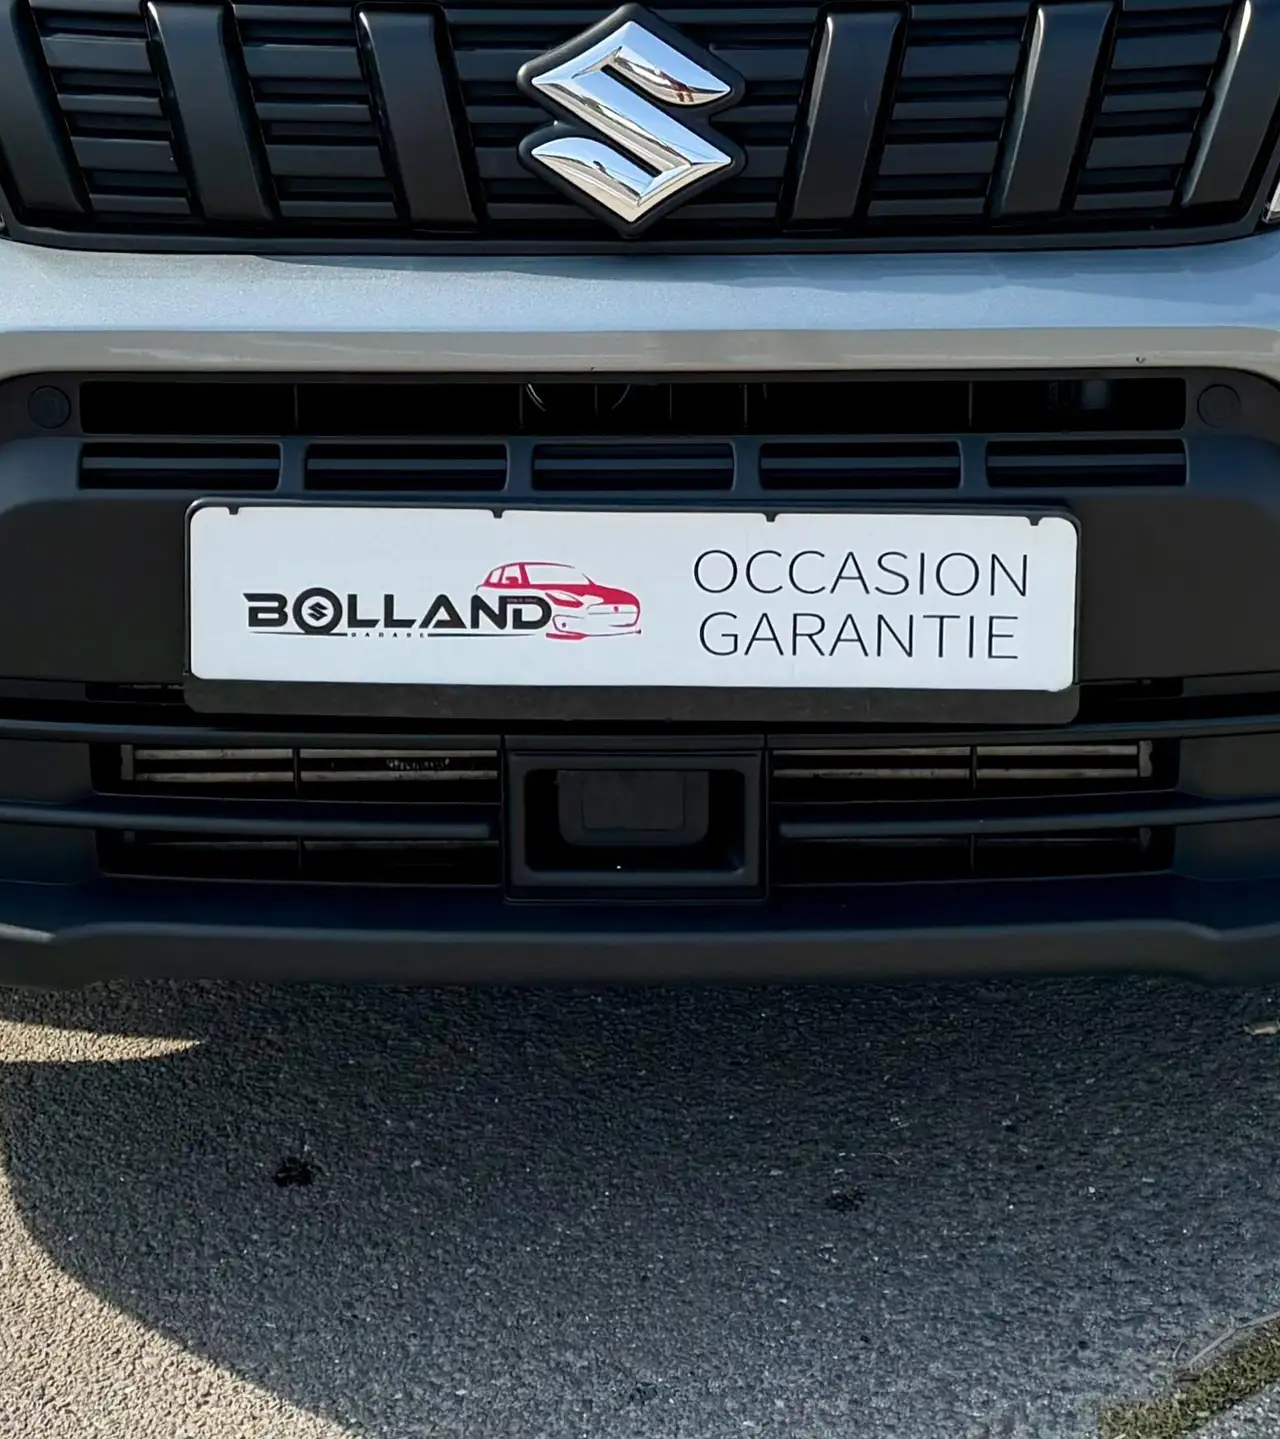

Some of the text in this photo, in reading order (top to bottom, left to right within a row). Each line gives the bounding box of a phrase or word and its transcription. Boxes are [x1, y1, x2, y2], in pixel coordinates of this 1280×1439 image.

[693, 549, 1027, 597] OCCASION
[242, 586, 553, 635] BOLLAND
[699, 611, 1019, 660] GARANTIE
